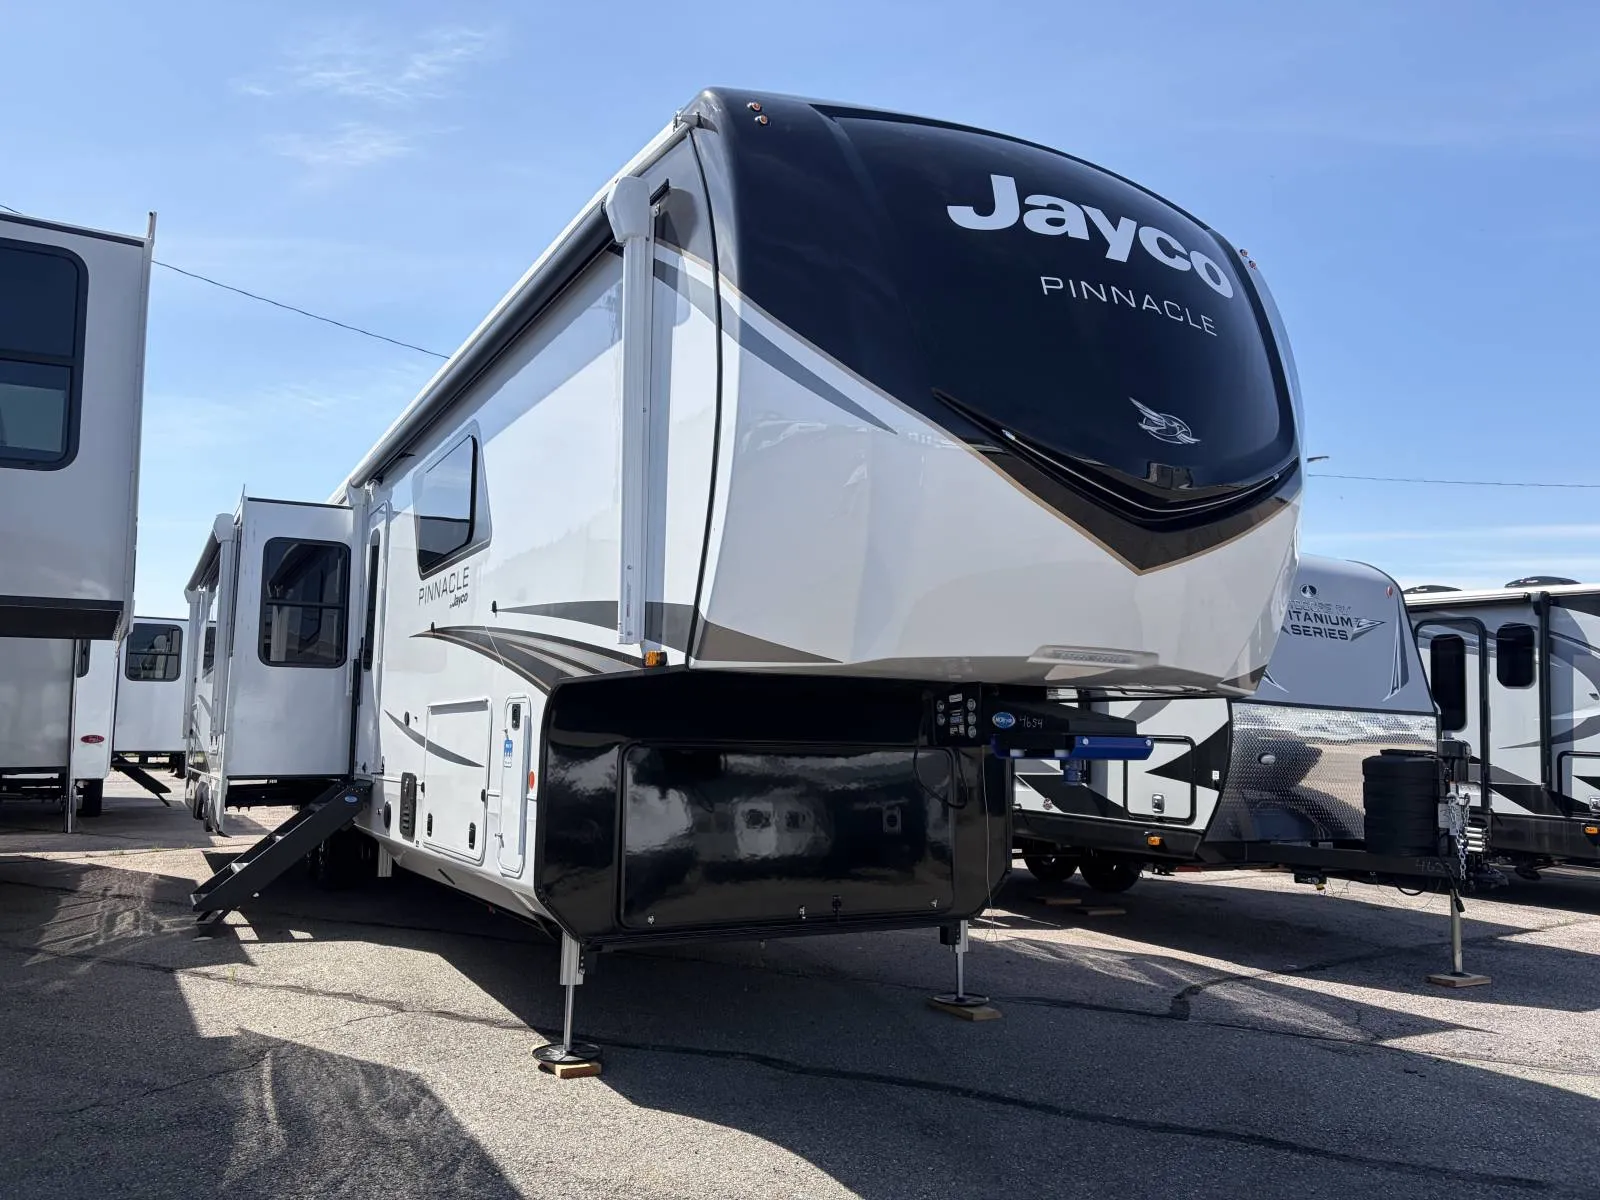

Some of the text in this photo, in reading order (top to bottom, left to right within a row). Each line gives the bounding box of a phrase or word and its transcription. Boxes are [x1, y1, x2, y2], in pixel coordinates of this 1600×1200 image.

[947, 174, 1234, 299] Jayco
[1040, 275, 1218, 337] PINNACLE
[418, 566, 470, 606] PINNACLE
[1288, 609, 1353, 628] ITANIUM
[1290, 624, 1349, 641] SERIES
